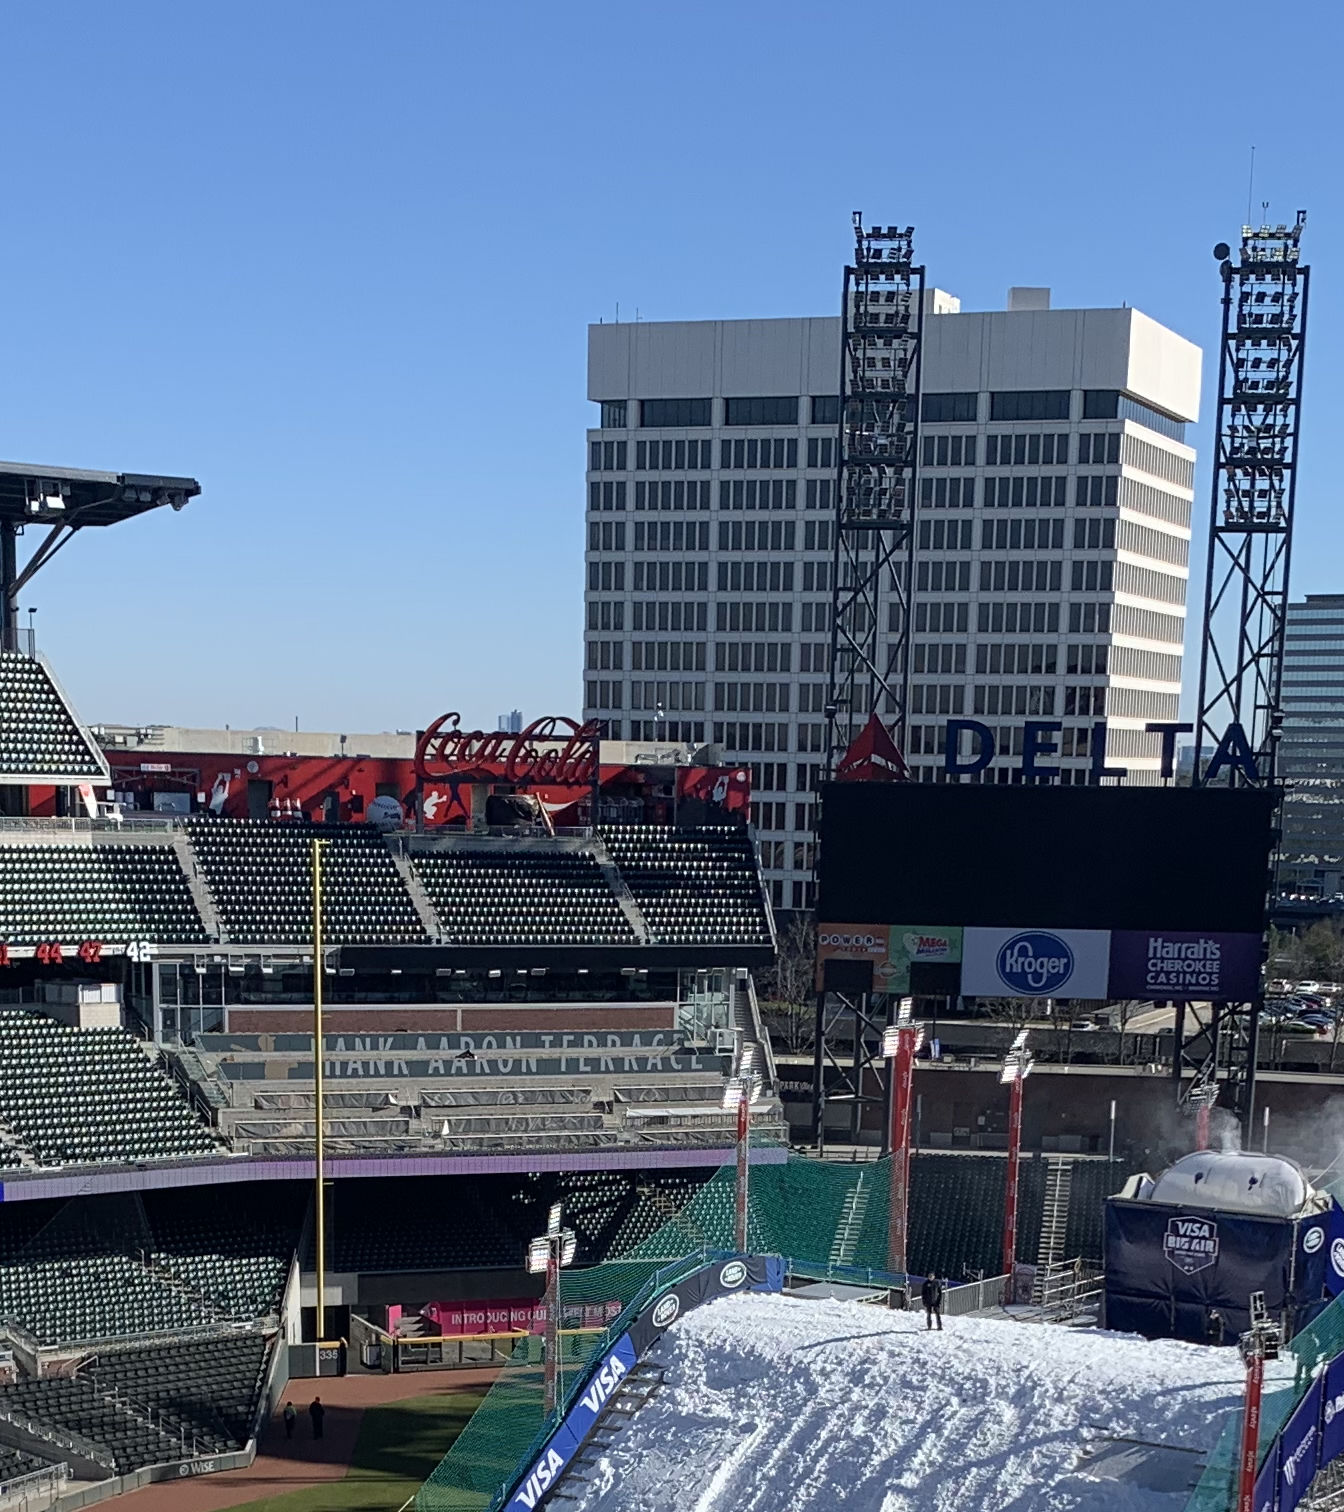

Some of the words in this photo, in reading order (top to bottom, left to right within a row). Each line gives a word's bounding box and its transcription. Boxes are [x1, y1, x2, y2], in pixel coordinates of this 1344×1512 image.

[945, 718, 1262, 779] DELTA
[820, 934, 874, 945] POWER
[37, 942, 62, 964] 44
[78, 942, 102, 963] 47
[126, 941, 151, 962] 42
[1148, 937, 1221, 959] Harrah's
[1006, 941, 1067, 988] Kroger
[1147, 959, 1220, 972] CHEROKEE
[1146, 973, 1219, 985] CASINOS
[1176, 1221, 1210, 1237] VISA
[1167, 1236, 1189, 1249] BIG
[1191, 1238, 1214, 1252] AIR
[452, 1311, 525, 1325] INTRODUCING
[319, 1350, 338, 1360] 335
[580, 1355, 626, 1413] VISA
[190, 1461, 215, 1474] WISE
[516, 1449, 564, 1509] VISA
